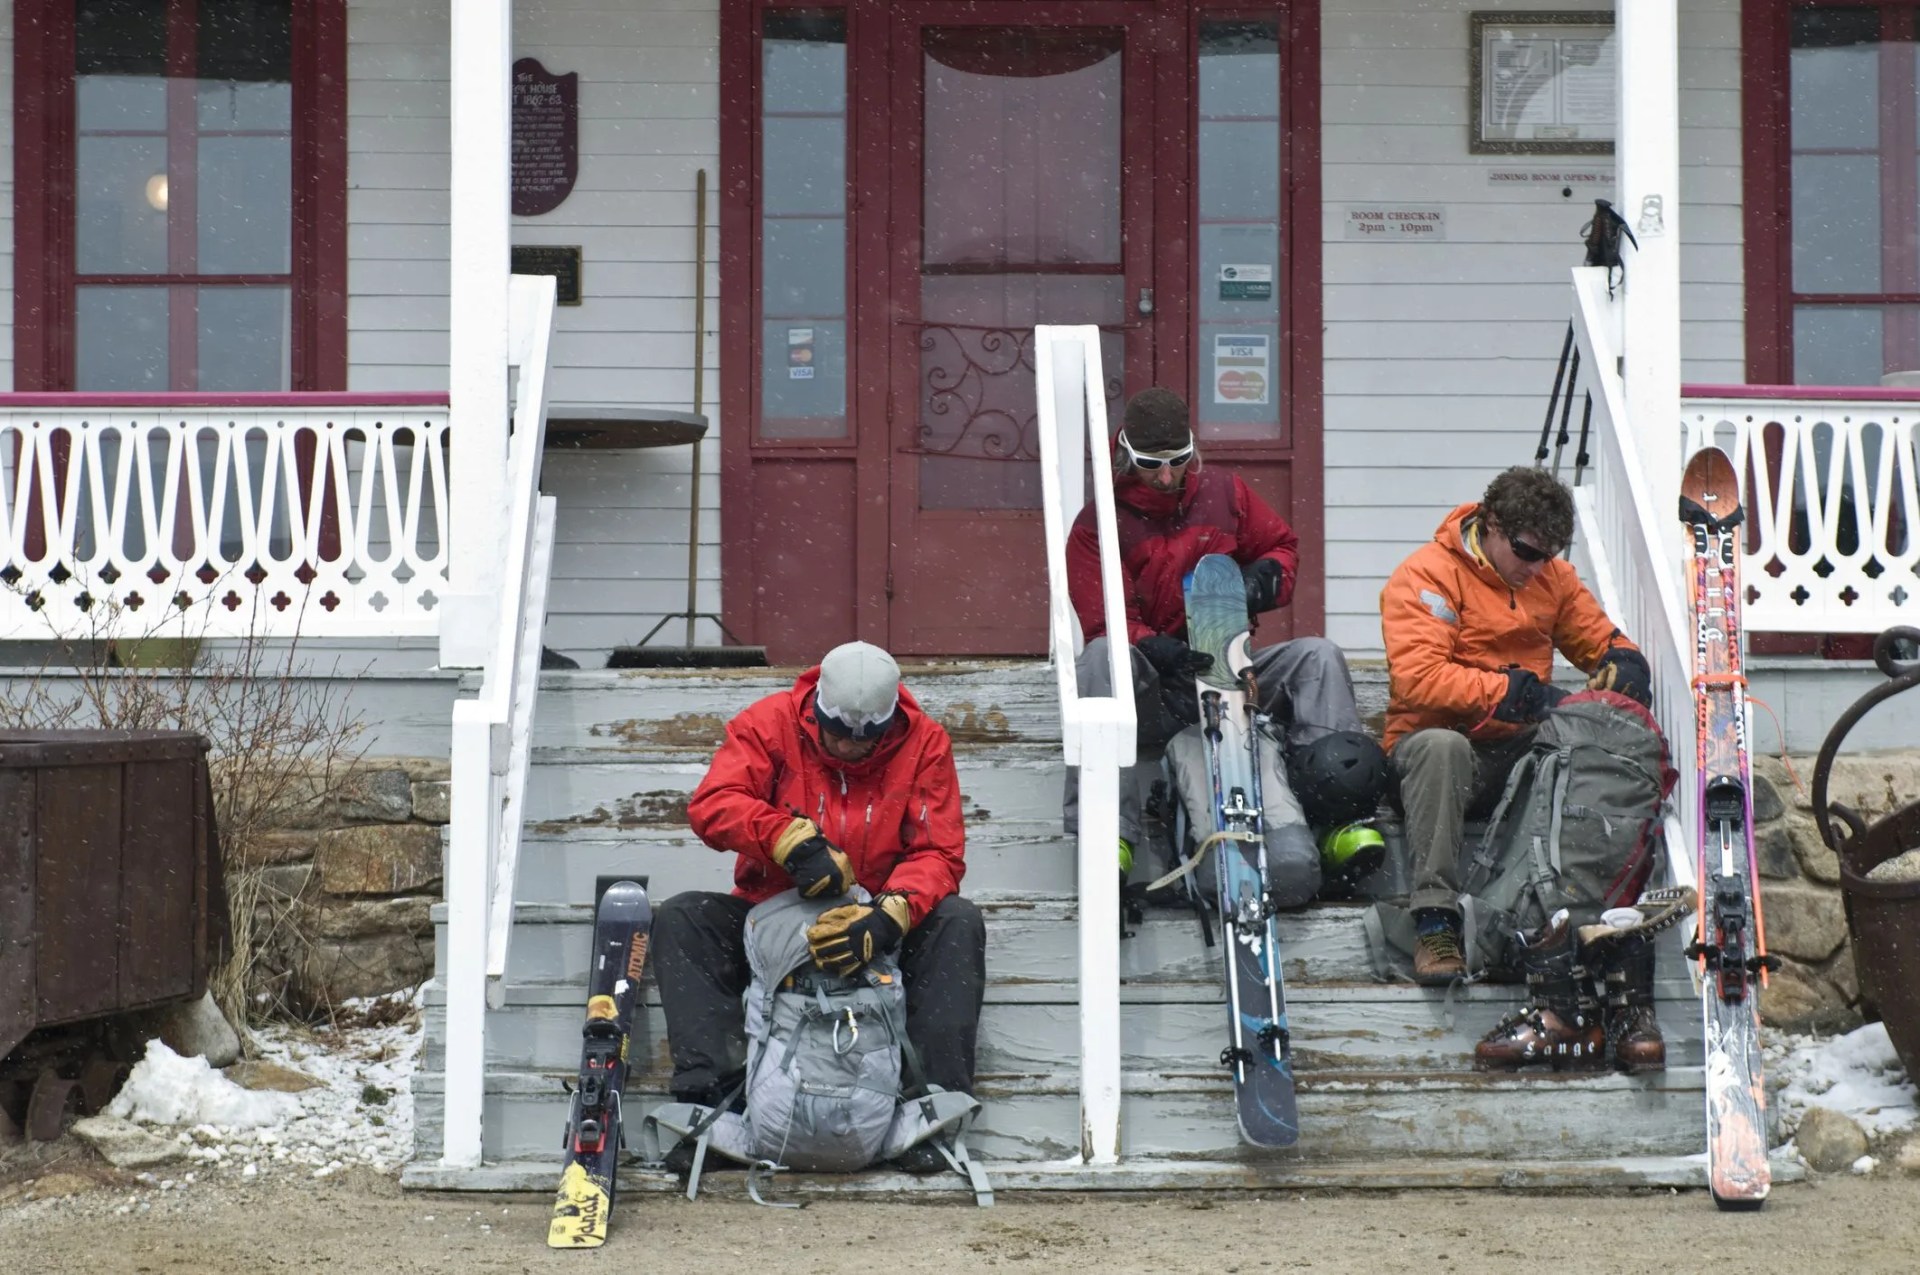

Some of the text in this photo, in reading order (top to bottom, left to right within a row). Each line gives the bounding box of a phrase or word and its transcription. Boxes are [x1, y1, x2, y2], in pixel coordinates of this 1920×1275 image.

[530, 83, 558, 94] HOUSE
[1490, 173, 1528, 181] DINING
[1531, 173, 1560, 181] ROOM
[1563, 173, 1597, 181] OPENS
[1351, 211, 1440, 221] ROOM CHECK-IN
[1358, 222, 1386, 234] 2pm
[1400, 222, 1433, 234] 10pm
[1230, 347, 1253, 356] VISA
[793, 368, 813, 377] VISA
[627, 931, 649, 982] ATOMIC
